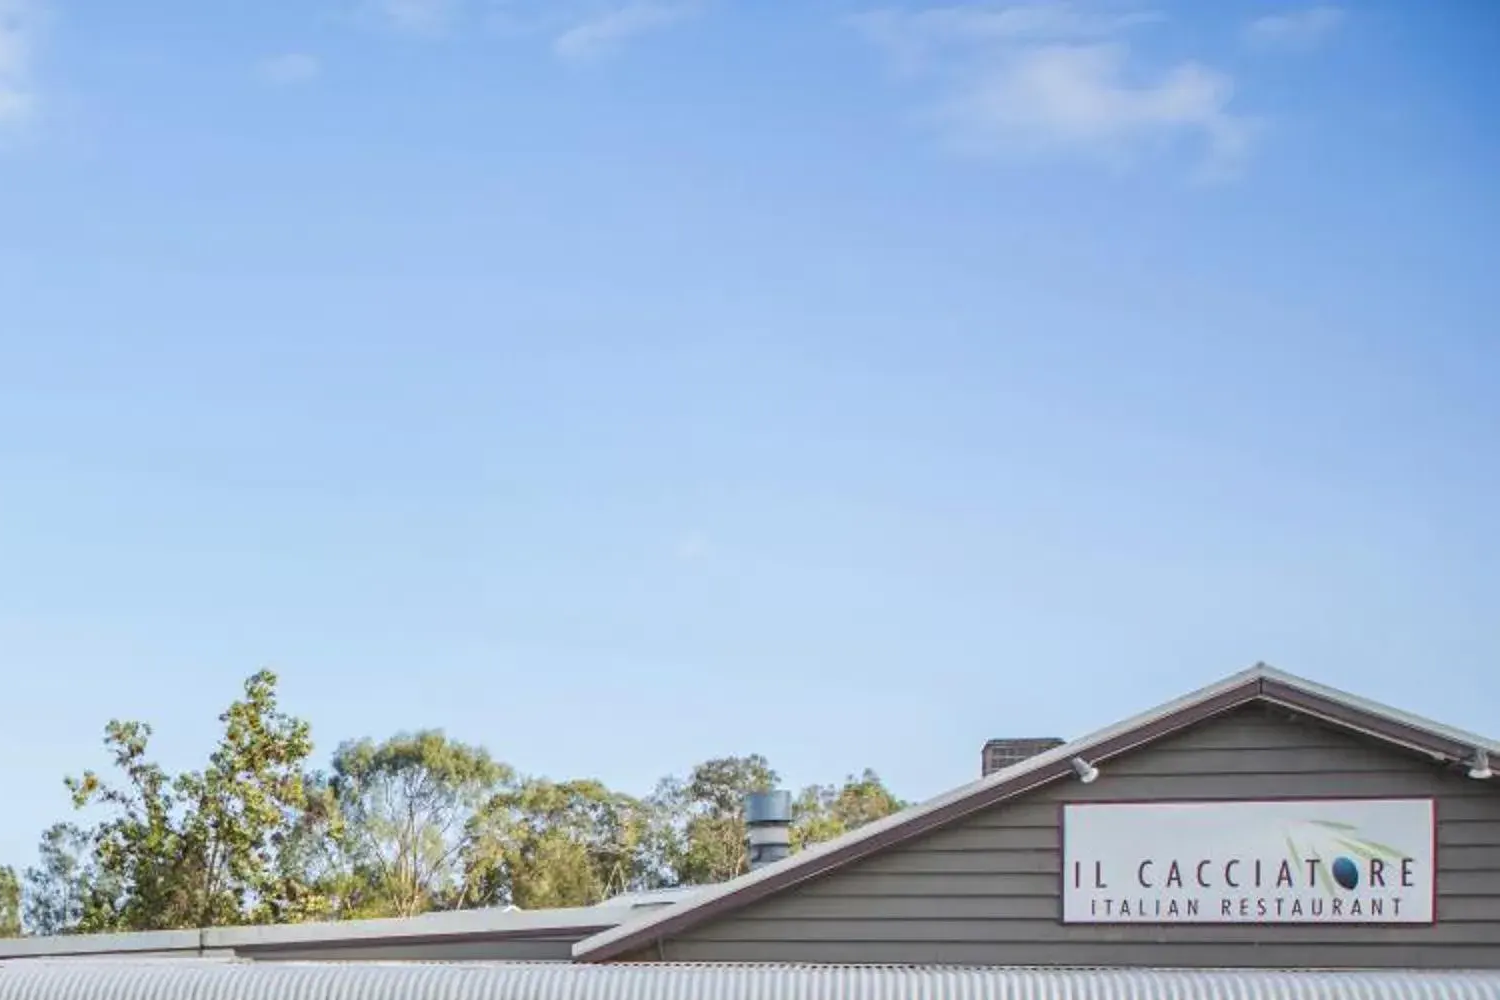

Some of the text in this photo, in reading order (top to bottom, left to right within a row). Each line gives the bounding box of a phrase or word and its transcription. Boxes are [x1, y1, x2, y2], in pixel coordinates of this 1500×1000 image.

[1074, 856, 1415, 891] IL CACCIATORE
[1091, 898, 1403, 917] ITALIAN RESTAURANT
